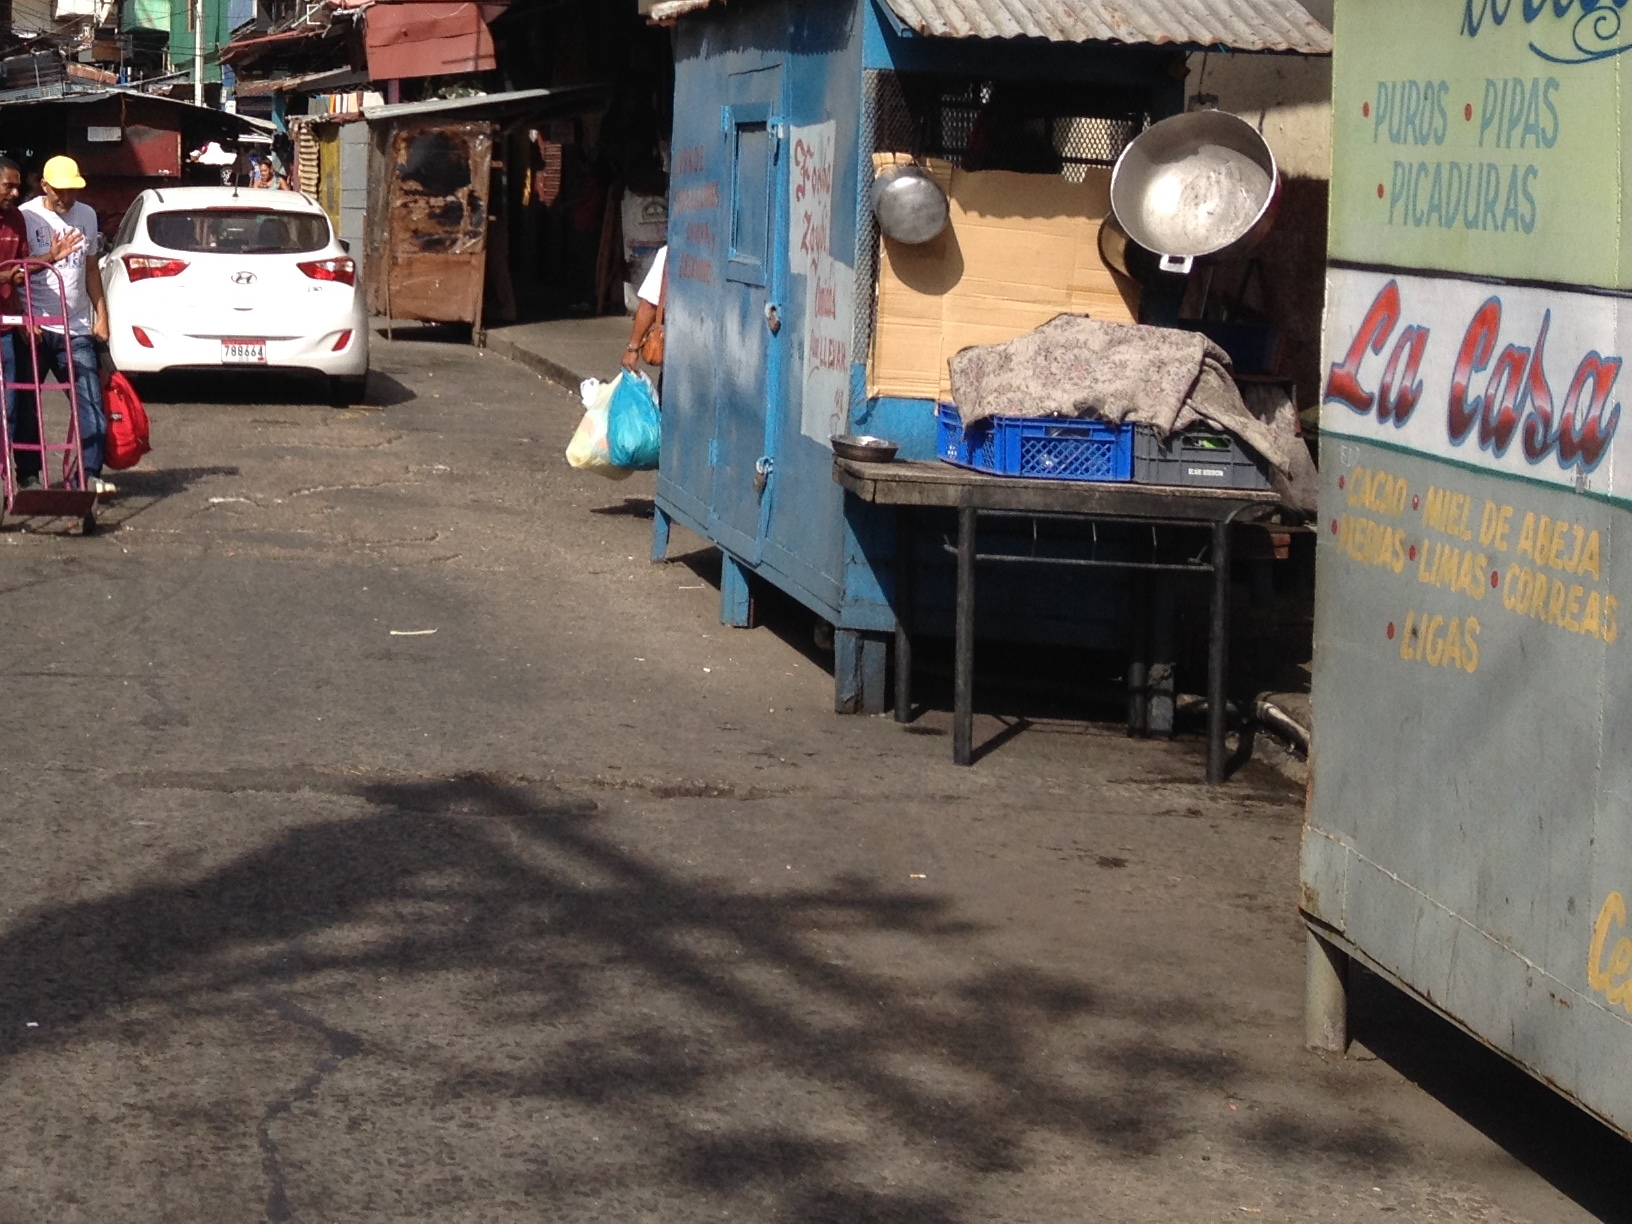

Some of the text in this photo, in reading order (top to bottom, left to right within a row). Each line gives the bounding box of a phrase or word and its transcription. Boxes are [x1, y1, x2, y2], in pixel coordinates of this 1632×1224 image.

[1374, 77, 1559, 148] PUROS PIPAS
[1388, 160, 1538, 234] PICADURAS
[1324, 279, 1622, 474] La Casa
[1346, 465, 1601, 582] CACAO MIEL DE ABEJA
[1419, 538, 1489, 601] LIMAS
[1502, 562, 1618, 644] CORREAS
[1399, 608, 1481, 673] LIGAS
